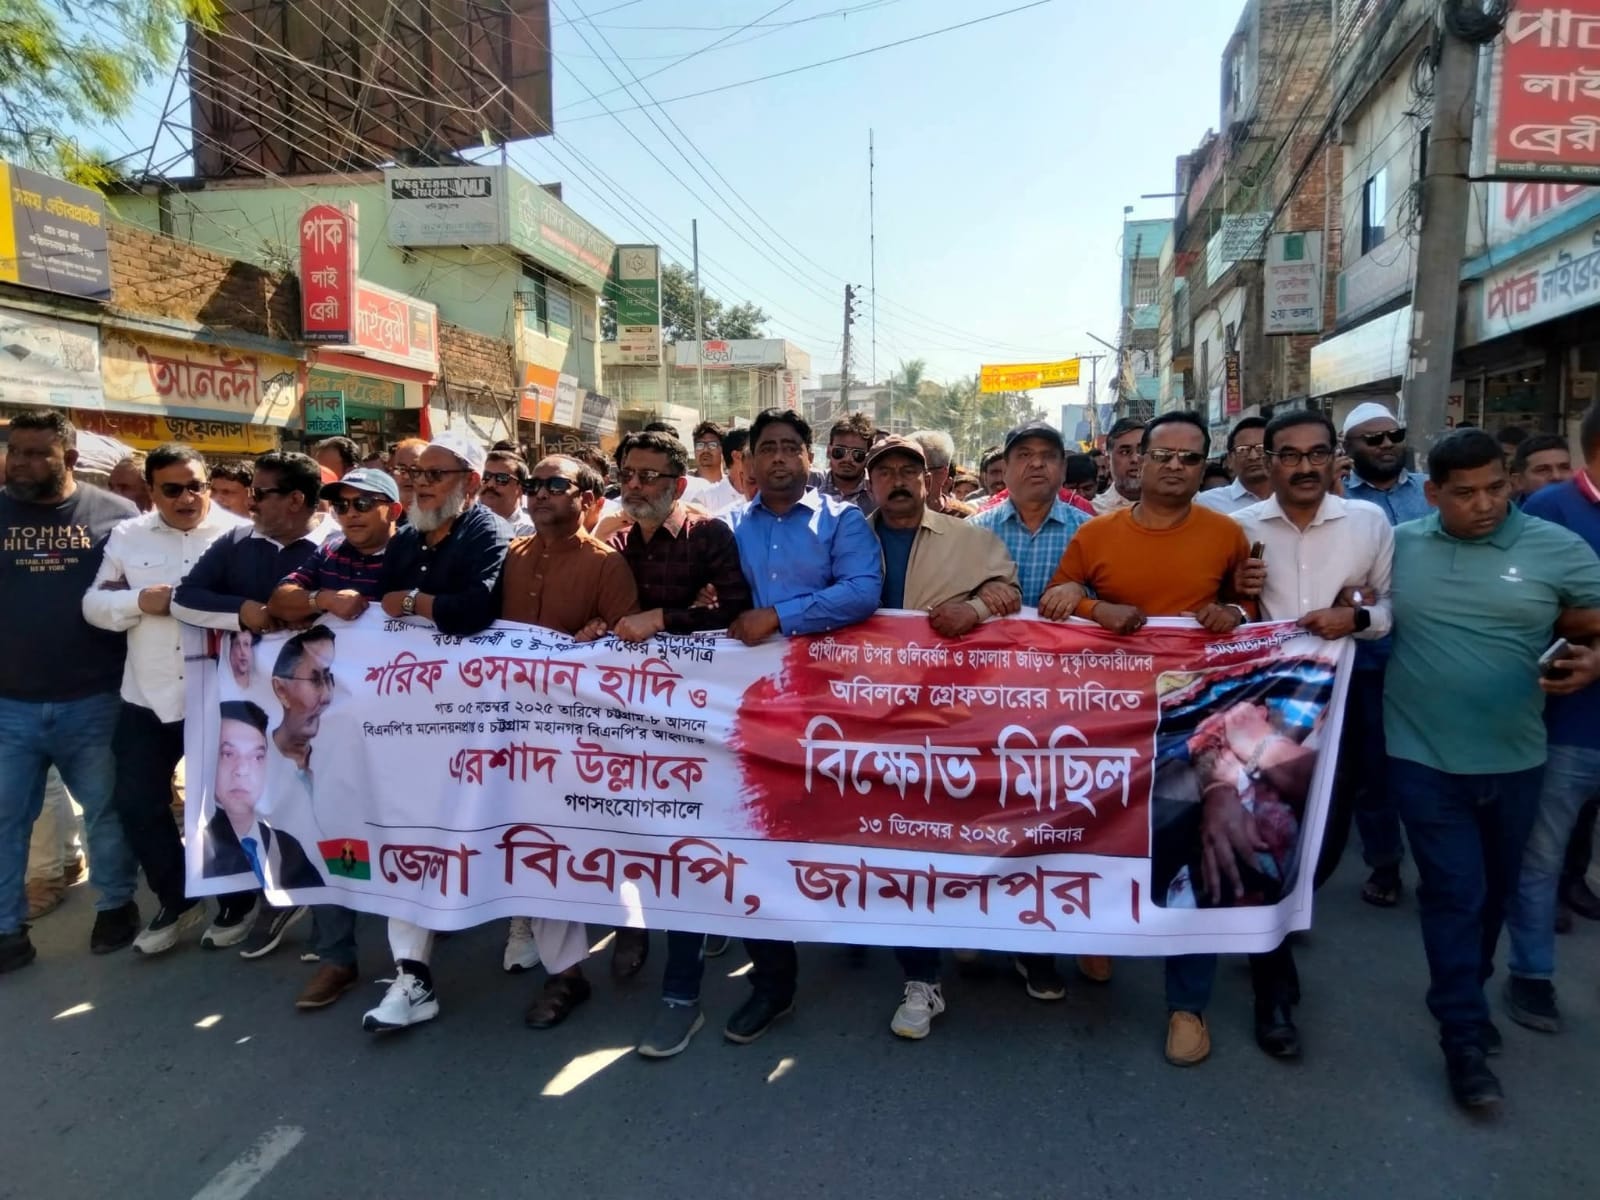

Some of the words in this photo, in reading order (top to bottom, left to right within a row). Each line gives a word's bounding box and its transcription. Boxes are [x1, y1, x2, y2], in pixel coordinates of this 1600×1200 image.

[395, 178, 448, 190] WESTERN
[303, 214, 344, 255] পাক
[310, 265, 338, 290] লাই
[309, 296, 338, 322] ব্রেরী
[306, 395, 341, 413] পাক
[3, 537, 91, 551] HILFIGER
[8, 525, 88, 538] TOMMY
[30, 565, 46, 573] NEW
[657, 642, 717, 664] মুখপাত্র
[808, 636, 859, 665] প্রার্থীদের
[863, 640, 893, 665] উপর
[896, 641, 949, 668] গুলিবর্ষণ
[953, 649, 964, 667] ও
[967, 648, 1012, 670] হামলায়
[1015, 646, 1057, 673] জড়িত
[365, 651, 449, 696] শরিফ
[458, 655, 587, 698] ওসমান
[596, 657, 684, 708] হাদি
[688, 688, 708, 709] ও
[828, 674, 922, 707] অবিলম্বে
[928, 682, 1051, 710] গ্রেফতারের
[1056, 680, 1145, 712] দাবিতে
[434, 701, 454, 715] গত
[457, 702, 473, 715] ০৫
[476, 700, 511, 714] নভেম্বর
[515, 701, 553, 715] ২০২৫
[558, 701, 601, 719] তারিখে
[664, 716, 708, 732] আসনে
[489, 718, 530, 734] চট্টগ্রাম
[535, 719, 583, 735] মহানগর
[449, 741, 562, 786] এরশাদ
[571, 737, 709, 793] উল্লাকে
[796, 714, 984, 804] বিক্ষোভ
[991, 724, 1142, 818] মিছিল
[564, 791, 705, 820] গণসংযোগকালে
[858, 815, 882, 834] ১৩
[887, 812, 954, 840] ডিসেম্বর
[959, 824, 1018, 848] ২০২৫,
[1023, 823, 1086, 846] শনিবার
[379, 842, 483, 898] জেলা
[493, 823, 761, 917] বিএনপি,
[786, 857, 1103, 932] জামালপুর
